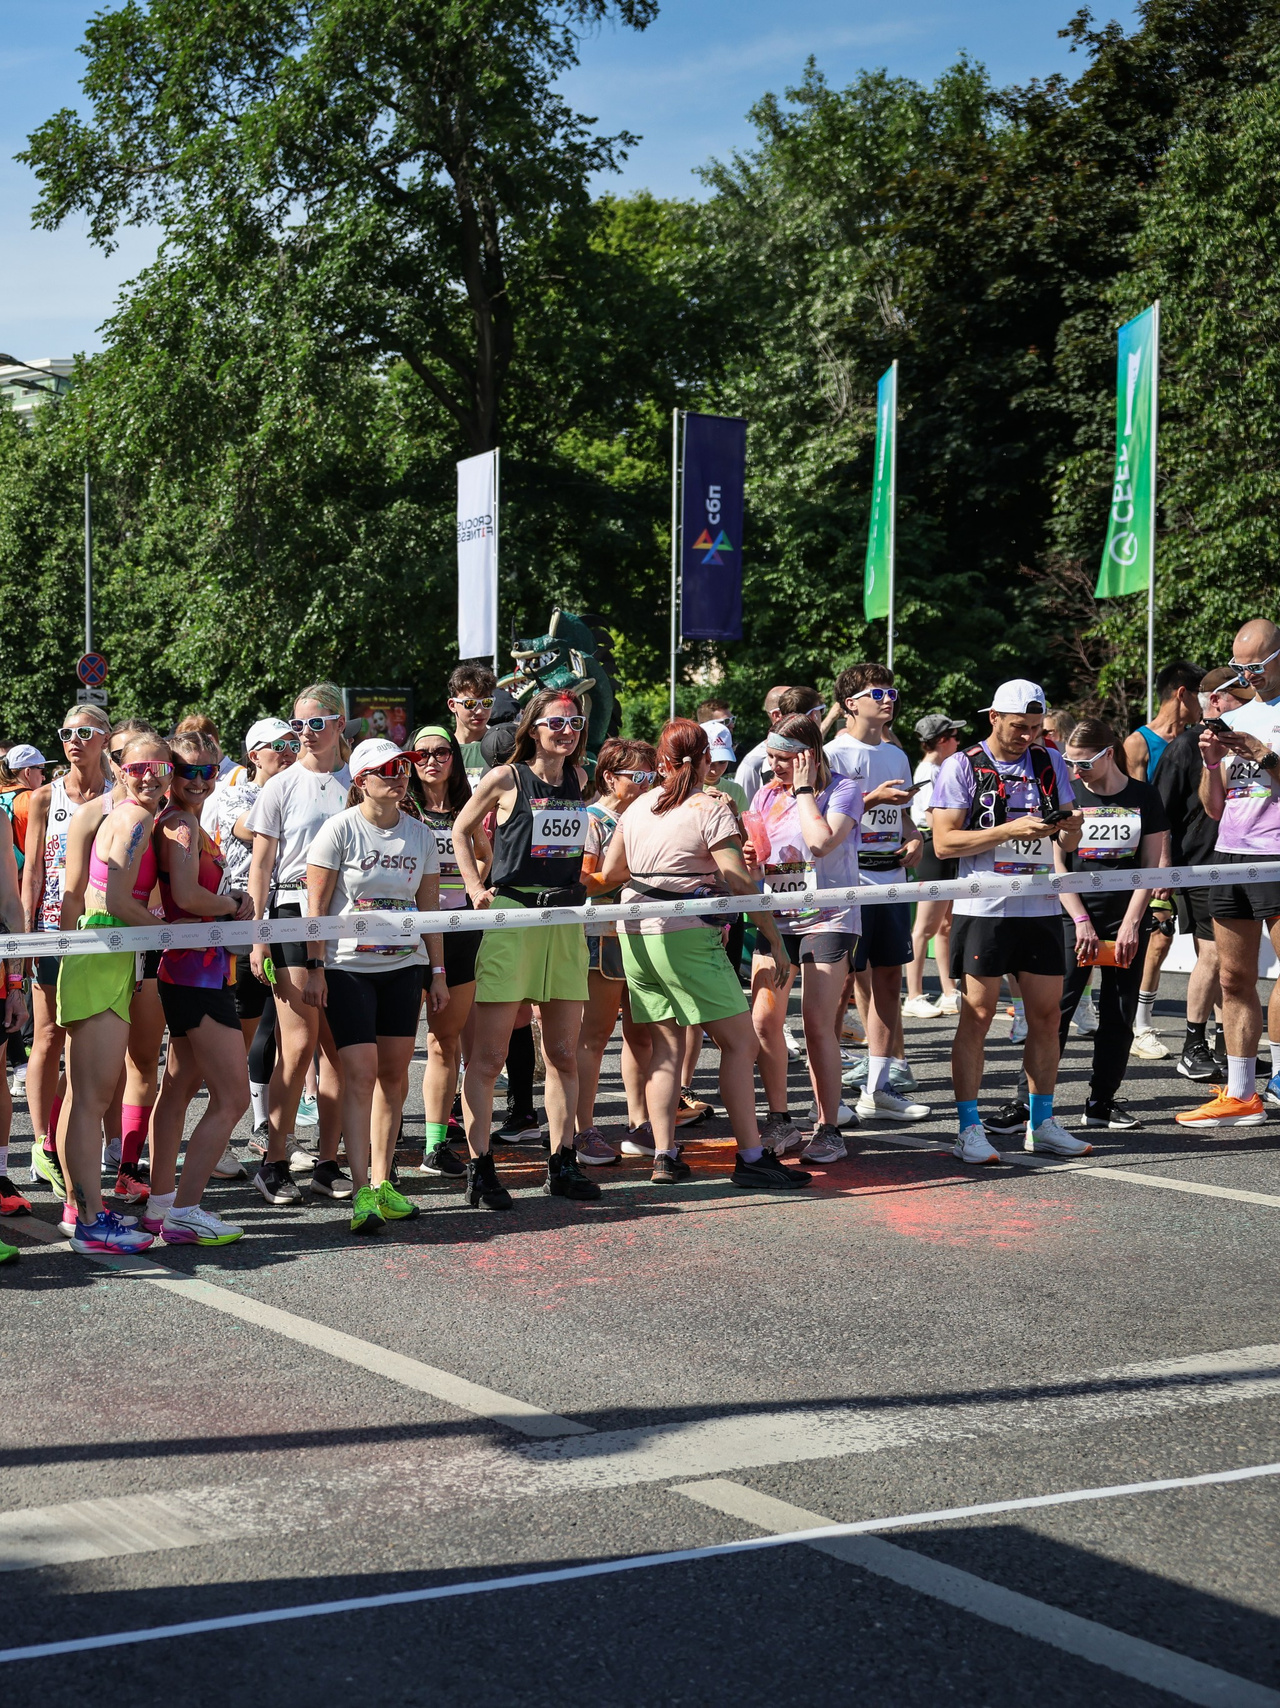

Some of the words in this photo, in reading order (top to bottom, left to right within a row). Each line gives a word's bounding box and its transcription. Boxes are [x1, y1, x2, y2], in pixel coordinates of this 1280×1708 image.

[705, 485, 721, 525] сбп
[869, 809, 898, 825] 7369
[542, 818, 581, 837] 6569
[1088, 825, 1131, 841] 2213
[436, 838, 454, 855] 58
[381, 855, 417, 871] asics
